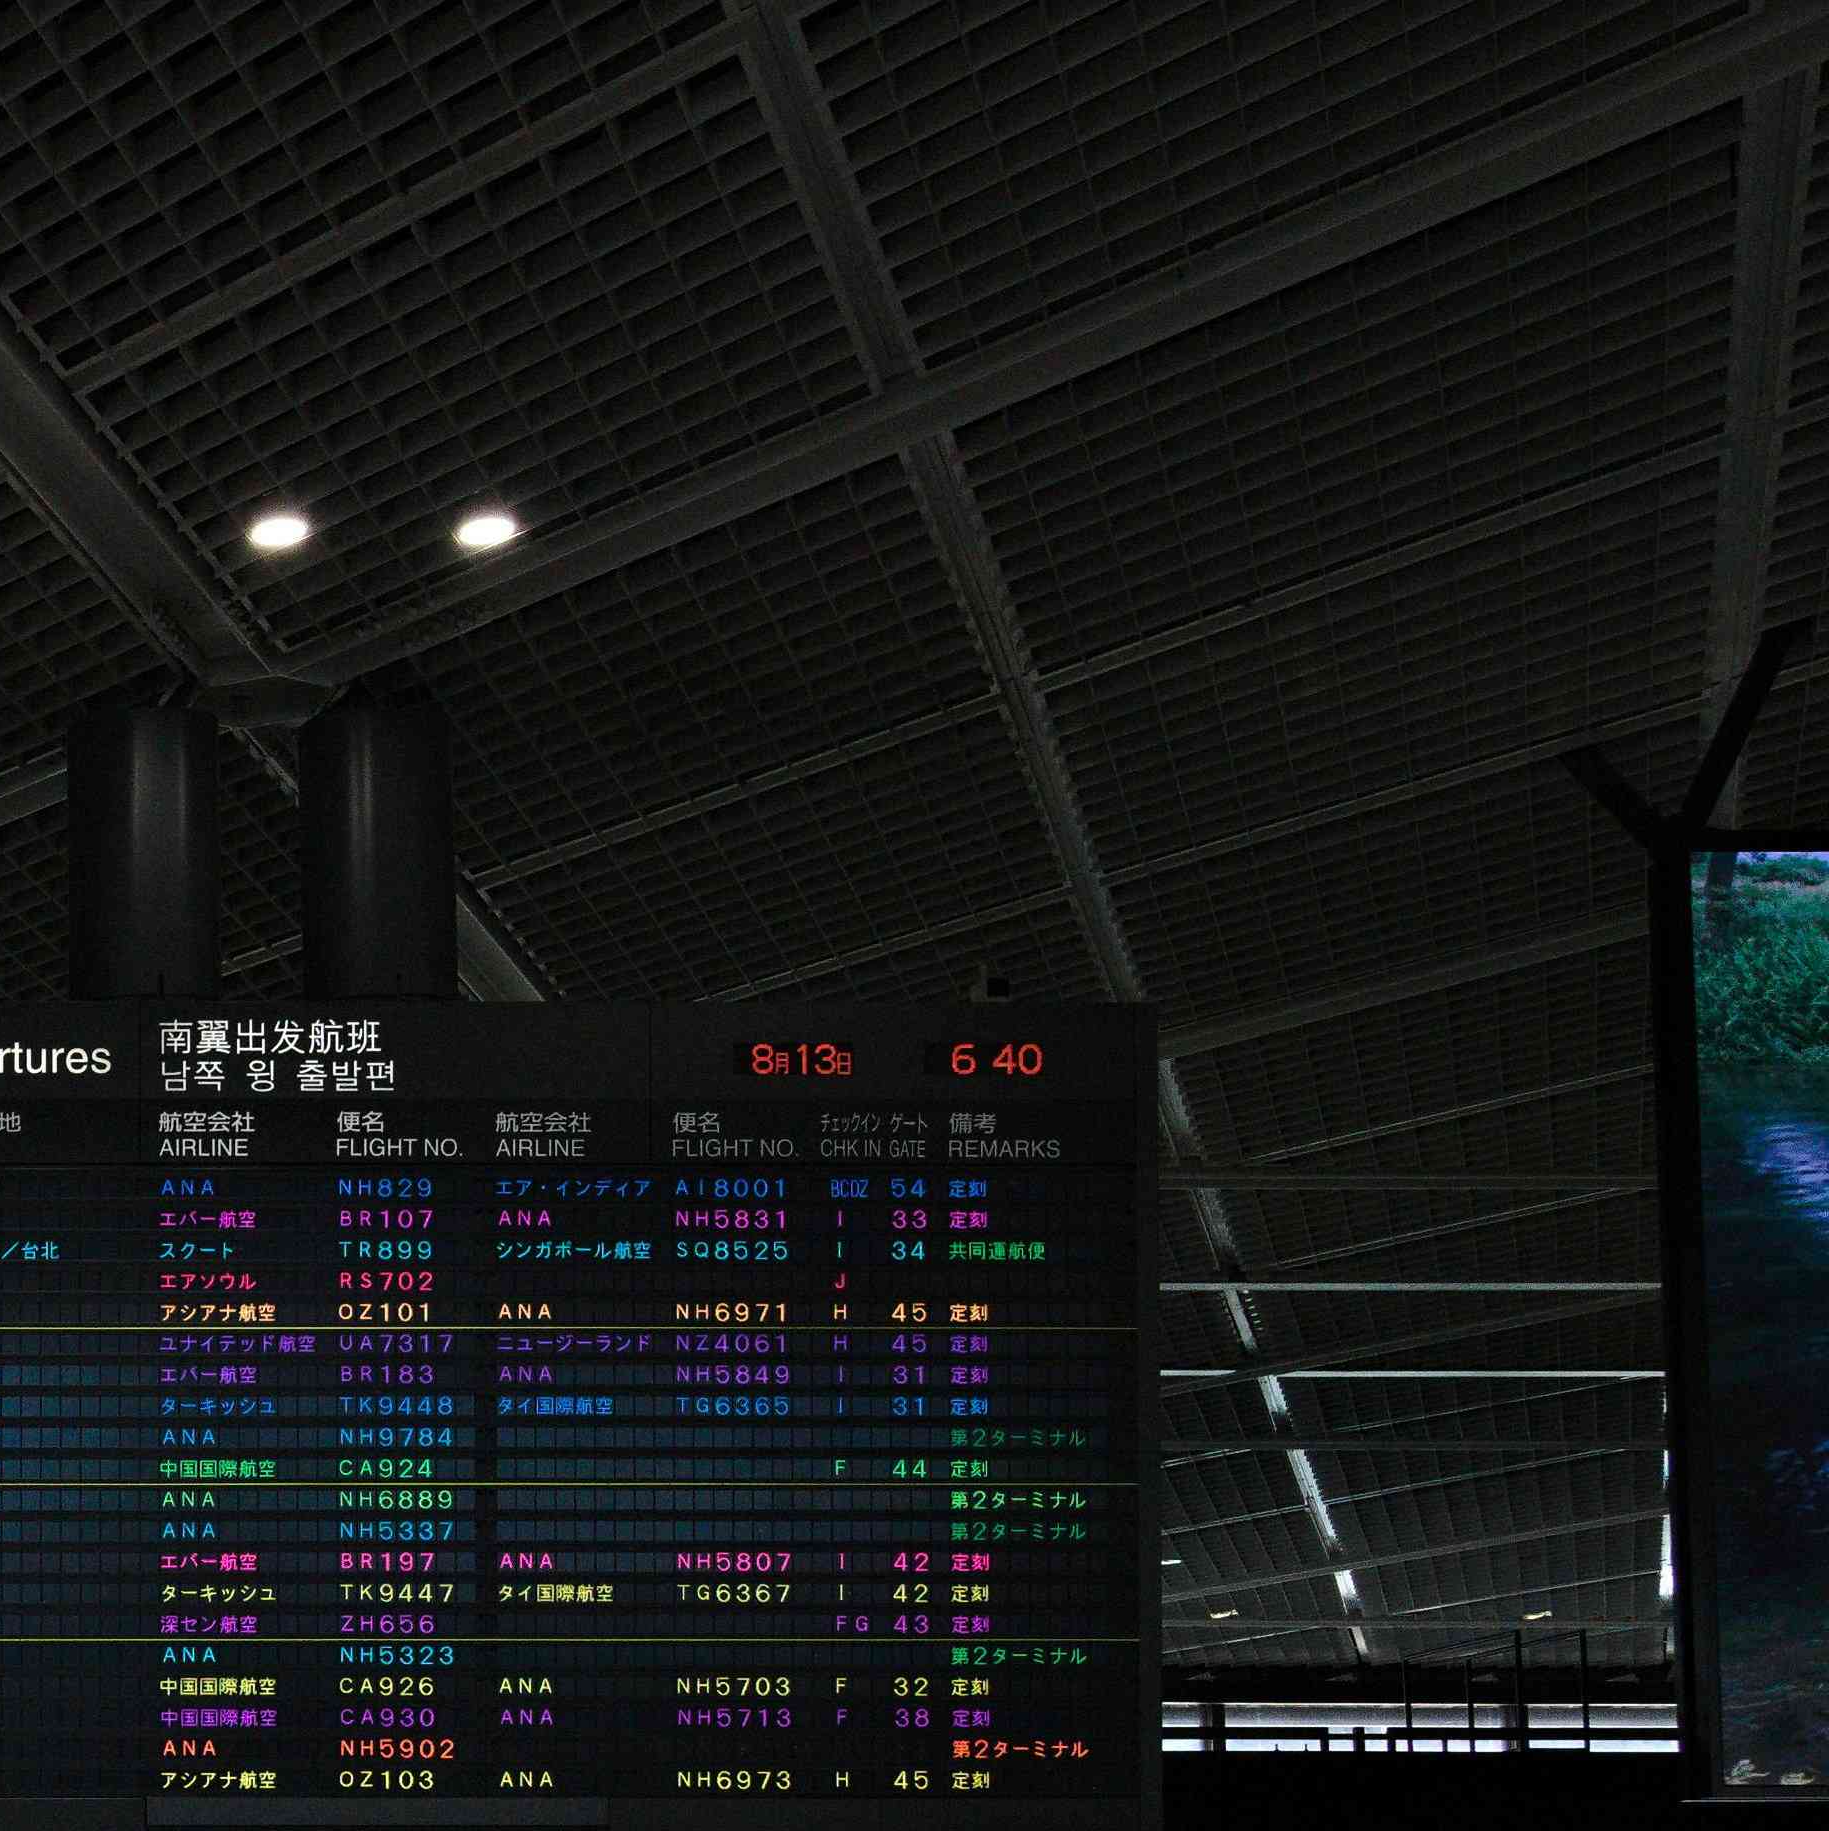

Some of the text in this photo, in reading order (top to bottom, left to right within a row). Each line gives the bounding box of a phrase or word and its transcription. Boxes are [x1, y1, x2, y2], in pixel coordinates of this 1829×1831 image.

[159, 1019, 382, 1055] 南翼出发航班
[751, 1043, 852, 1075] 8月13日
[951, 1043, 1043, 1075] 6 40
[161, 1059, 394, 1093] 남쪽 윙 출발편
[161, 1303, 276, 1323] アシアナ航空
[338, 1302, 429, 1322] OZ101
[498, 1303, 552, 1320] ANA
[675, 1302, 786, 1323] NH6971
[891, 1302, 927, 1323] 45
[949, 1303, 988, 1323] 定刻
[159, 1677, 276, 1696] 中国国際航空
[339, 1676, 434, 1697] CA926
[499, 1677, 553, 1694] ANA
[676, 1676, 791, 1697] NH5703
[893, 1676, 929, 1697] 32
[951, 1677, 989, 1697] 定刻
[163, 1739, 216, 1756] ANA
[340, 1738, 454, 1760] NH5902
[952, 1738, 1089, 1759] 第2ターミナル
